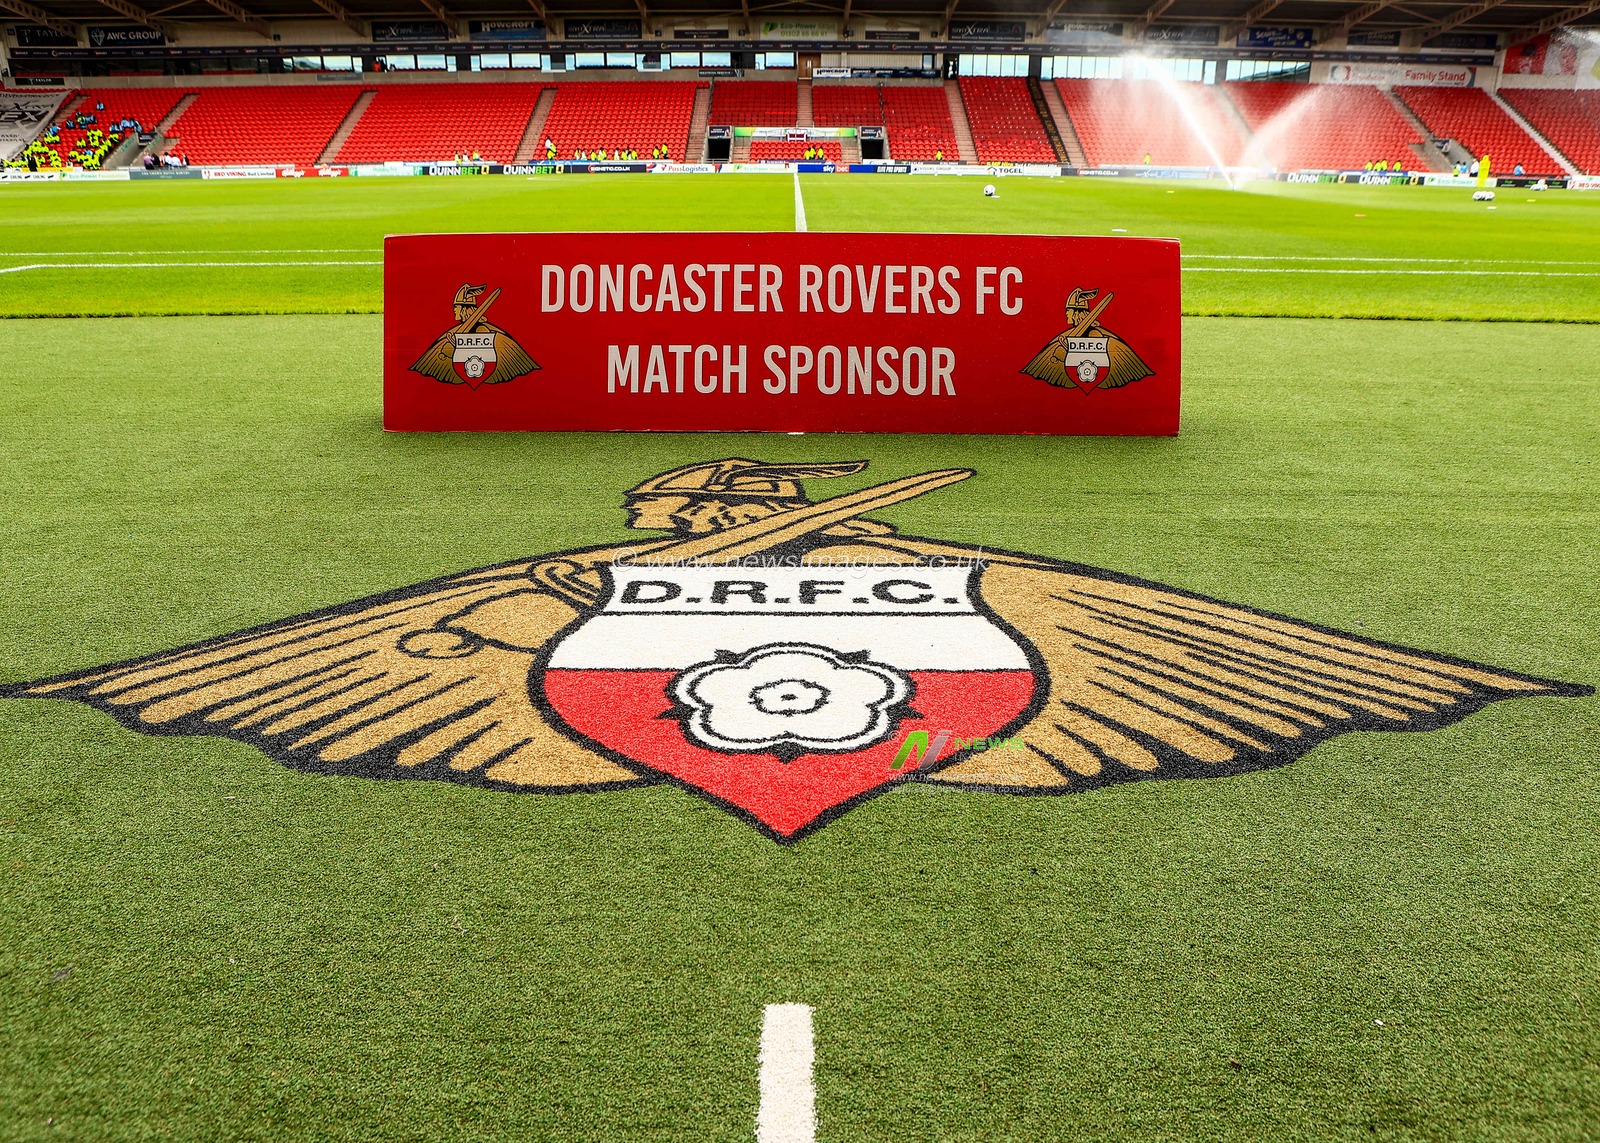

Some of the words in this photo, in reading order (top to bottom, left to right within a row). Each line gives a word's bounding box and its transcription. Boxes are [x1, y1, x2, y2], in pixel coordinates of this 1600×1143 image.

[482, 21, 535, 32] HOWCROFT
[107, 31, 126, 41] AWC
[128, 30, 162, 40] GROUP
[1405, 69, 1436, 82] Family
[1438, 70, 1466, 82] Stand
[429, 165, 480, 176] QUINNBET
[503, 164, 554, 175] QUINNBET
[668, 165, 709, 173] PassLogistics
[823, 165, 835, 173] sky
[1287, 172, 1337, 184] QUINNBET
[1359, 174, 1409, 185] QUINNBET
[1437, 177, 1473, 185] Eco-Power
[541, 264, 784, 313] DONCASTER
[800, 264, 961, 315] ROVERS
[975, 265, 1024, 316] FC
[456, 336, 493, 347] D.R.F.C.
[1069, 340, 1106, 352] D.R.F.C.
[607, 344, 747, 394] MATCH
[762, 344, 957, 397] SPONSOR
[619, 578, 960, 606] D.R.F.C.
